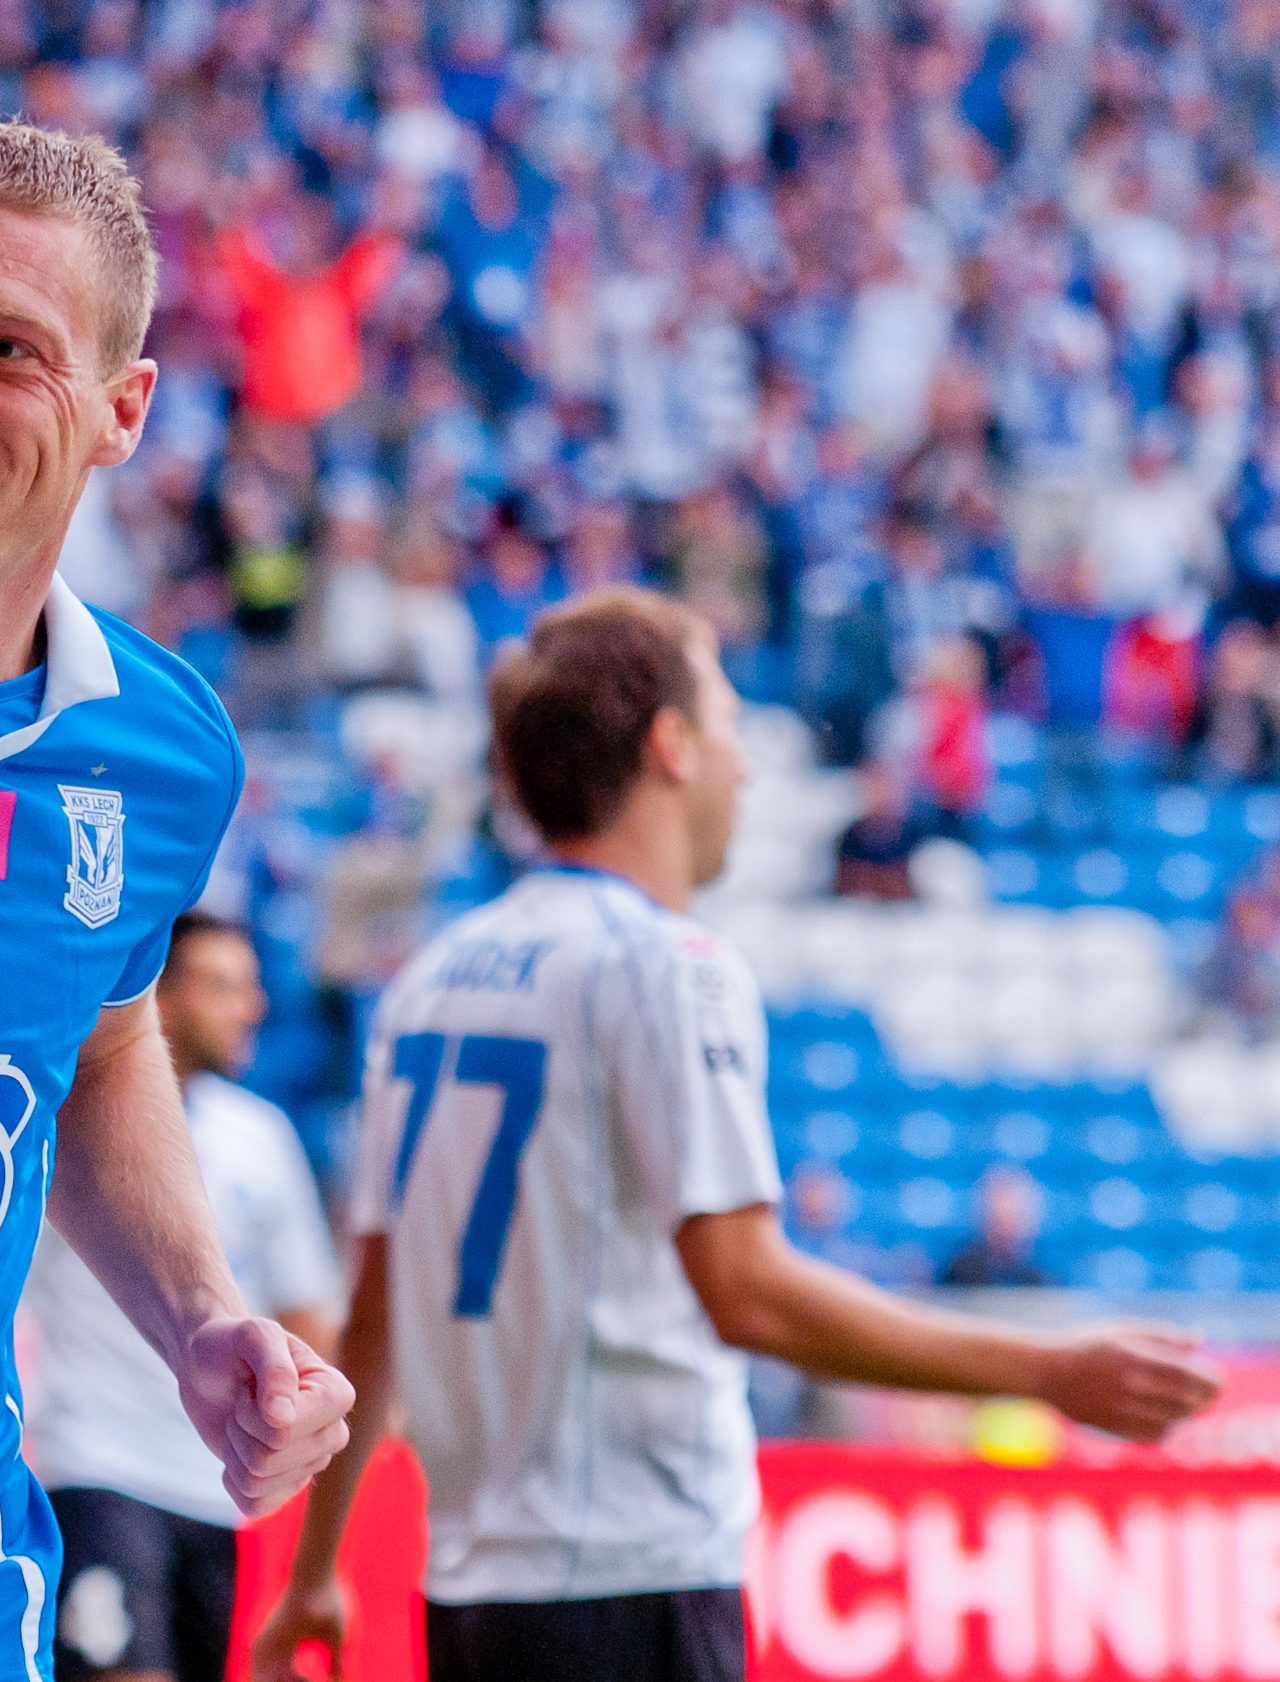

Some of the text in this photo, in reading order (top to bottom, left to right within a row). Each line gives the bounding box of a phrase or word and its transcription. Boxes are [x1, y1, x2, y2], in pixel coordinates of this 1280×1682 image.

[71, 795, 115, 811] KKS LECH
[744, 1490, 1280, 1680] CHNI
